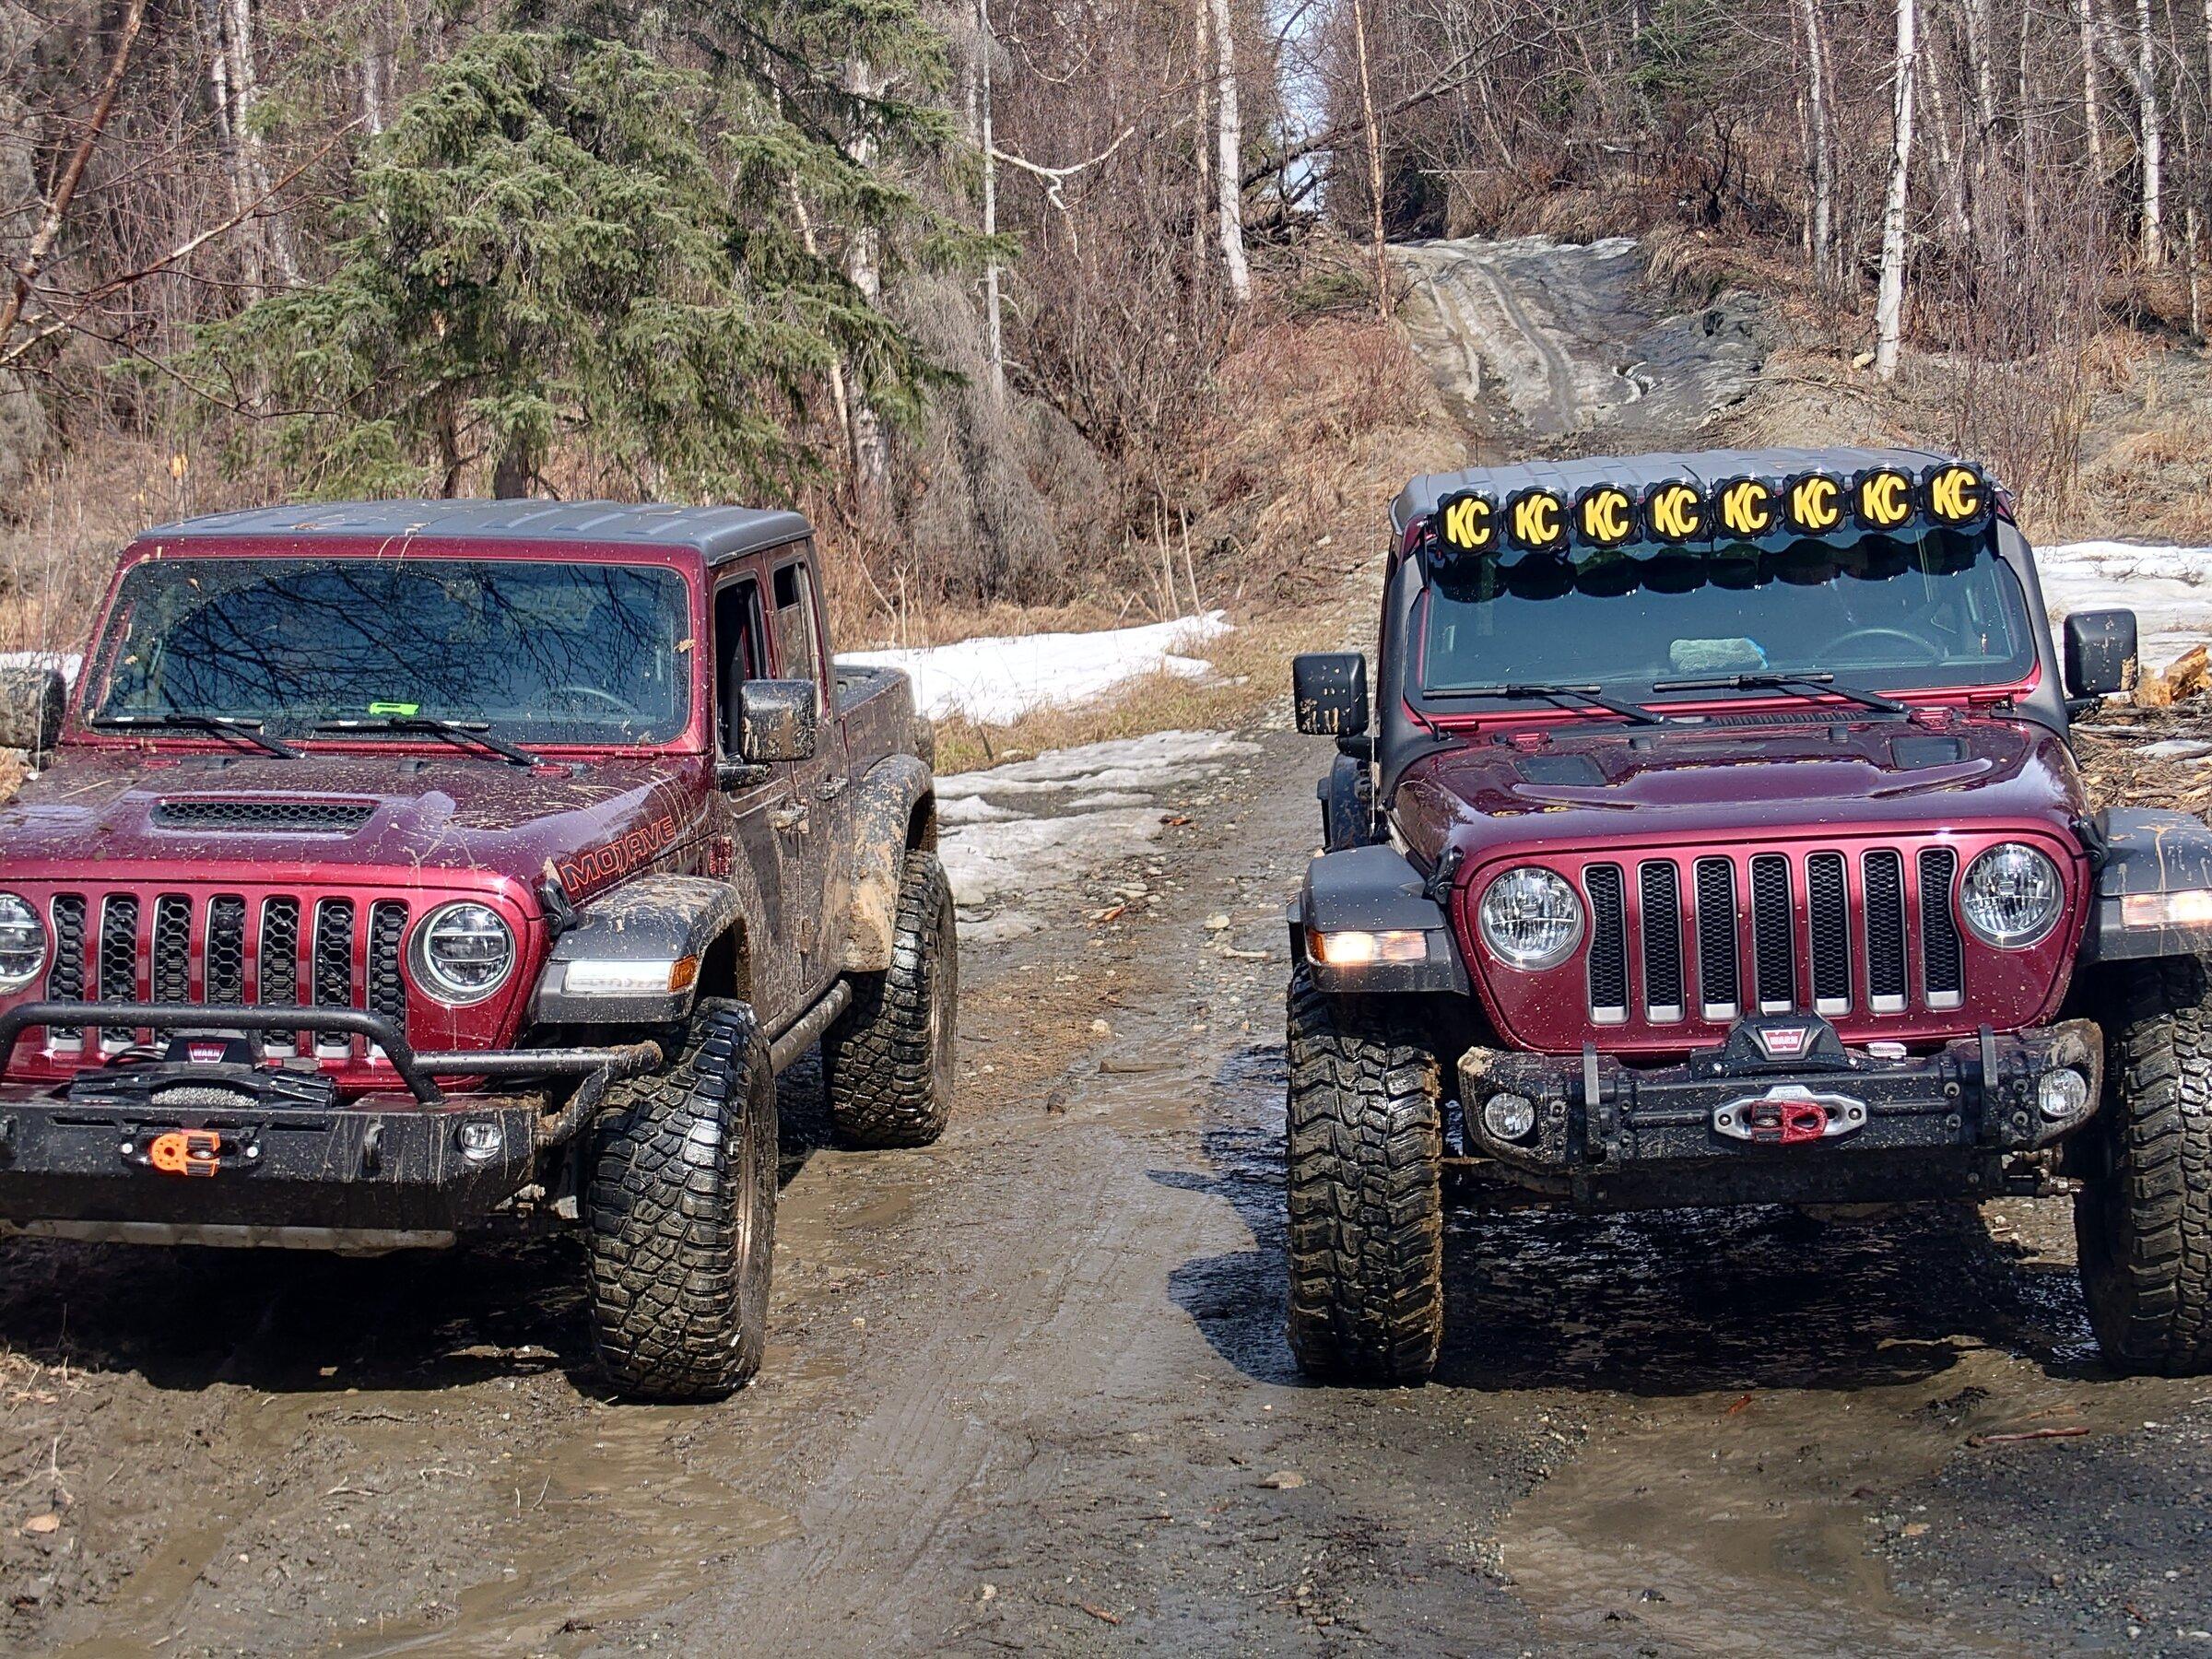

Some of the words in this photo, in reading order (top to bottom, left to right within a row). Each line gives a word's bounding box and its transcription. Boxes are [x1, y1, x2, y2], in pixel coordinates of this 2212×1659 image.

[1585, 491, 1629, 541] KC
[1654, 488, 1698, 536] KC
[1724, 482, 1768, 533] KC
[1794, 478, 1837, 528] KC
[1863, 474, 1906, 524] KC
[1933, 469, 1976, 519] KC
[1447, 499, 1489, 548] KC
[1516, 495, 1559, 544] KC
[560, 816, 677, 891] MOJAVE
